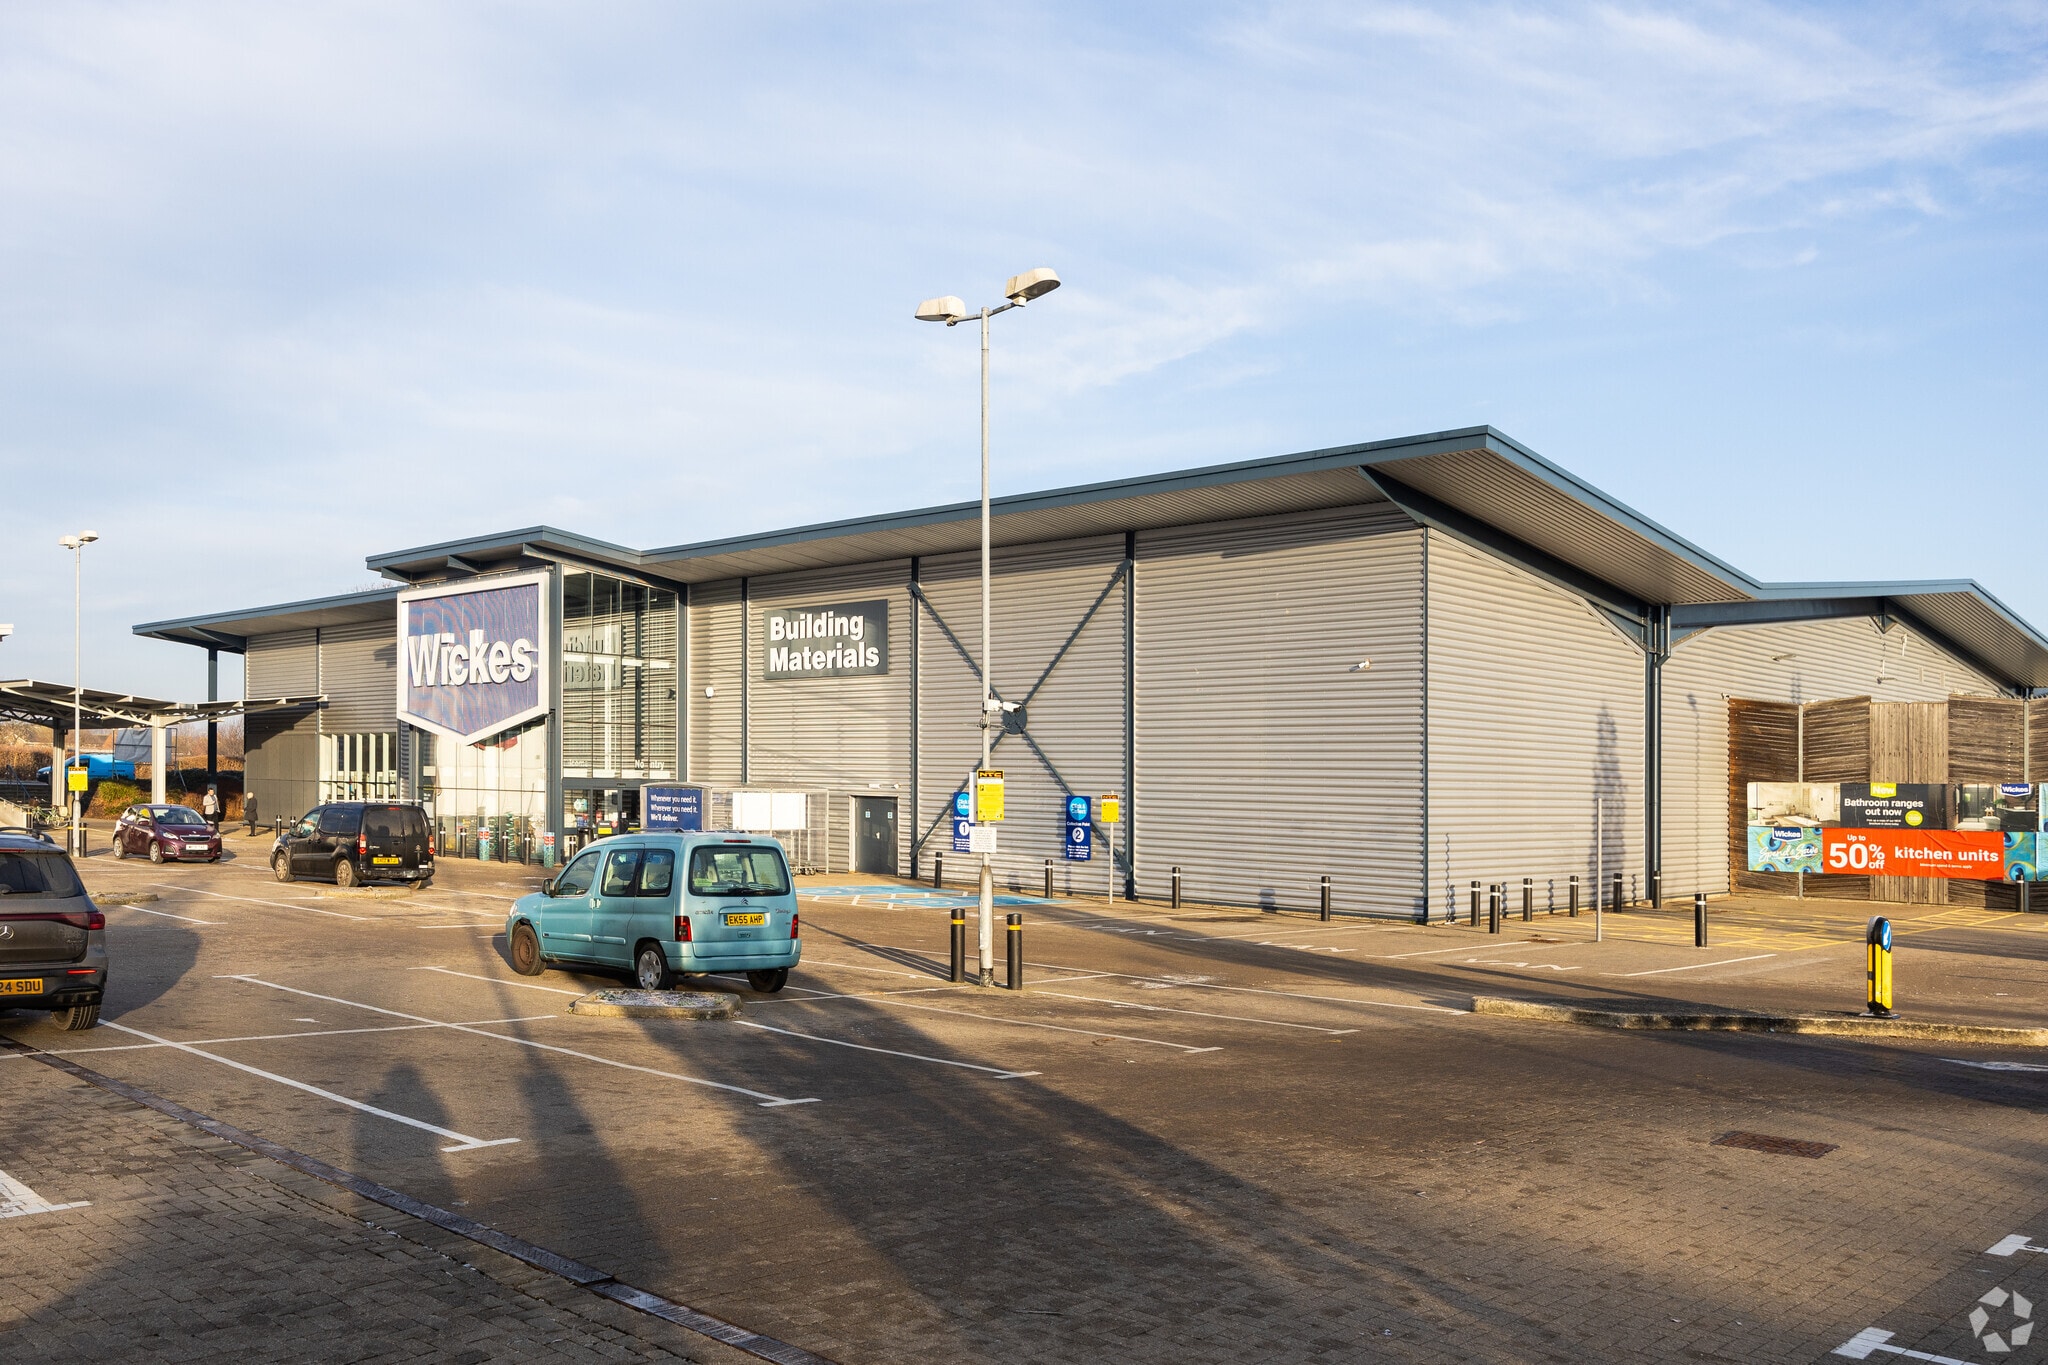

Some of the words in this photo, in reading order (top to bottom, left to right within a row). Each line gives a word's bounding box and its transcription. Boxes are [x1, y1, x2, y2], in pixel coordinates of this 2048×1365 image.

[770, 610, 864, 641] Building
[407, 628, 533, 687] Wickes
[769, 641, 880, 672] Materials
[634, 760, 645, 768] No
[646, 760, 664, 770] ntry
[1872, 786, 1895, 794] New
[1844, 798, 1889, 807] Bathroom
[1891, 800, 1924, 809] ranges
[1075, 830, 1081, 840] 2
[1894, 846, 1952, 860] kitchen
[1958, 849, 1999, 862] units
[1868, 860, 1884, 869] off
[728, 916, 748, 924] EK55
[750, 915, 763, 924] AHP
[16, 980, 40, 992] SDU
